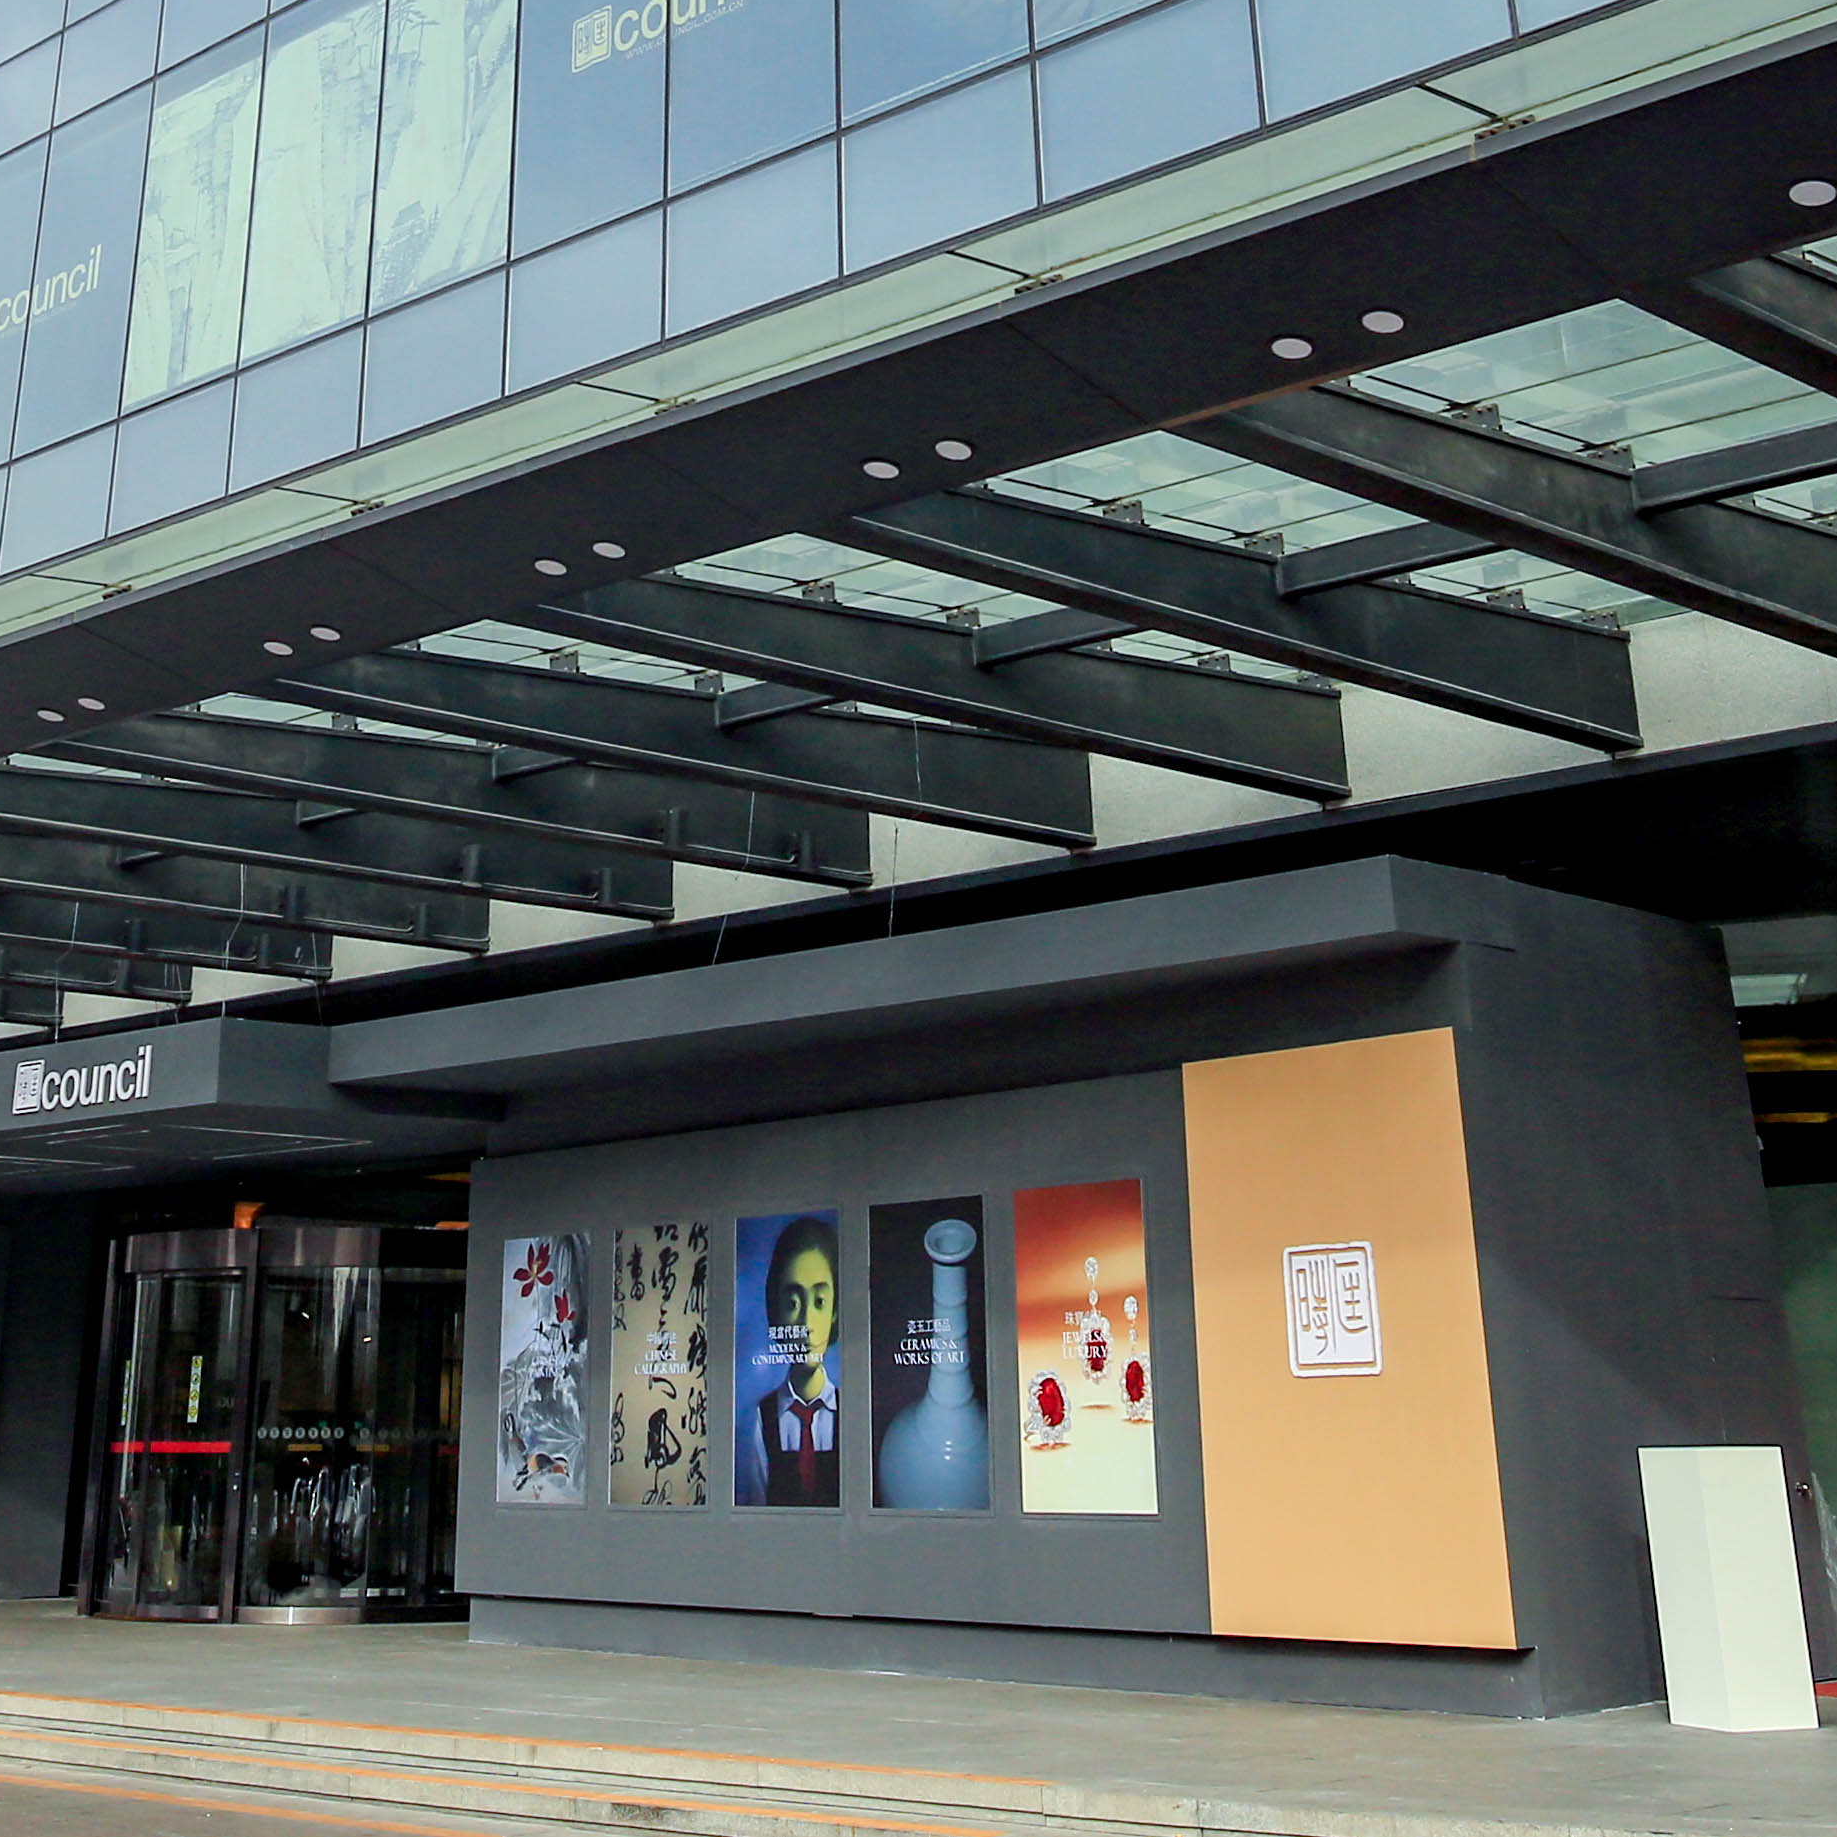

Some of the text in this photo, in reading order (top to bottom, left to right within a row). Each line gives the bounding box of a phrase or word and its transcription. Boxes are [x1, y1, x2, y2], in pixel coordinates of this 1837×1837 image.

[42, 1044, 154, 1111] council
[899, 1338, 949, 1352] CERAMICS
[894, 1350, 965, 1366] WORKS OF ART
